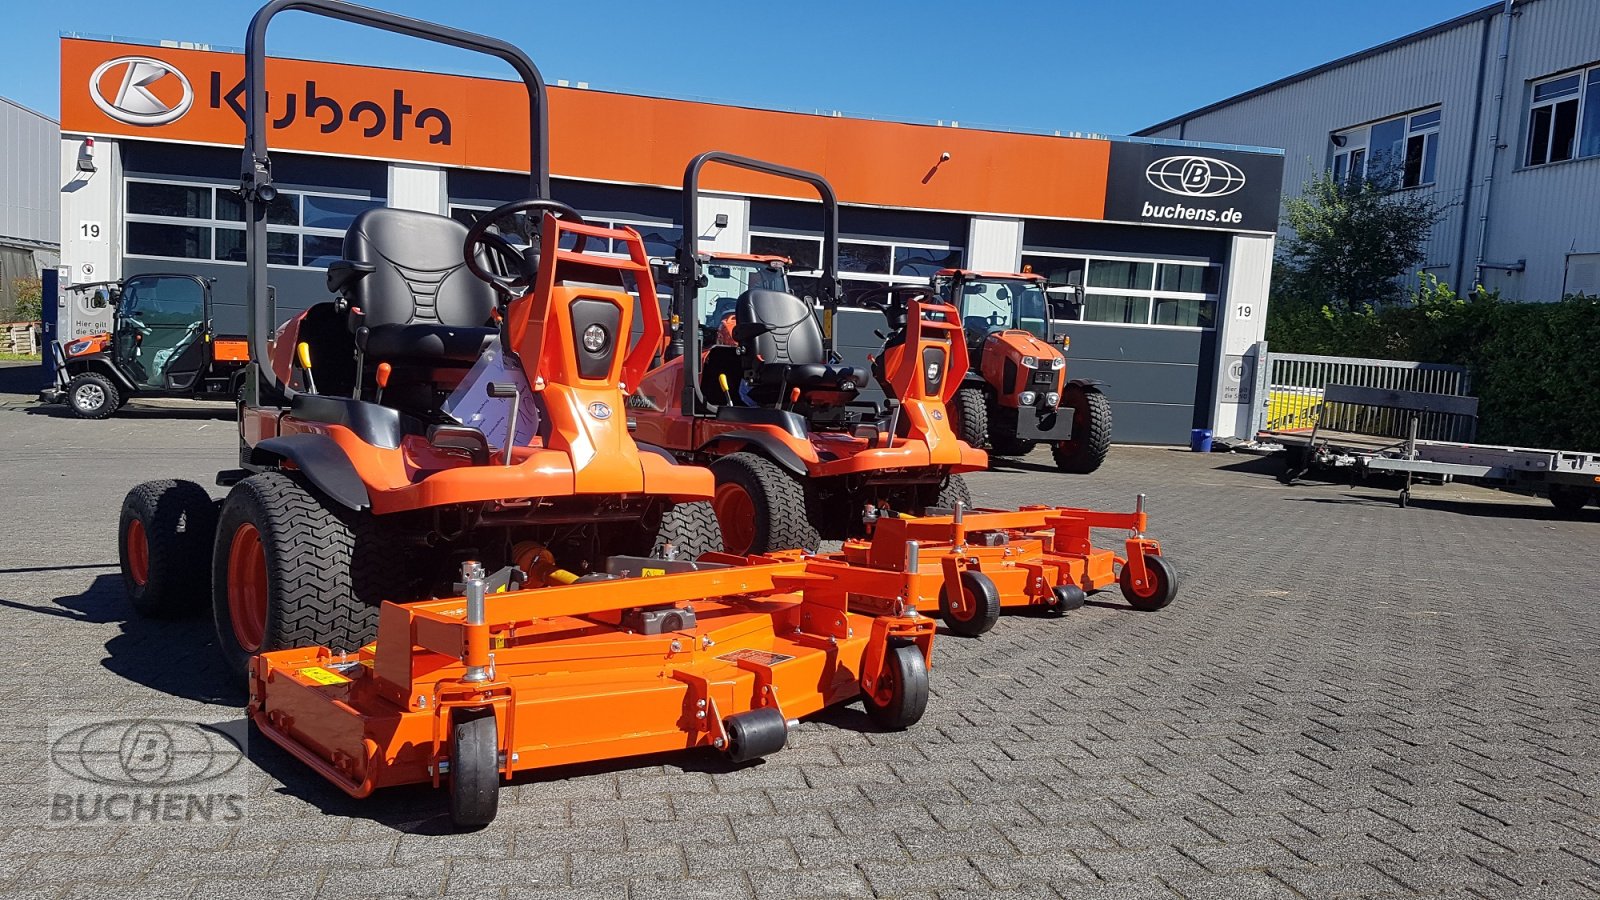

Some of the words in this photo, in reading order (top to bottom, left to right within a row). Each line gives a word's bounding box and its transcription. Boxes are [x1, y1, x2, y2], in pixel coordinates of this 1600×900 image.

[210, 71, 451, 146] Kubota
[1141, 201, 1243, 223] buchens.de
[81, 223, 100, 238] 19
[1237, 306, 1251, 317] 19
[94, 321, 107, 329] gilt
[1233, 366, 1244, 377] 10
